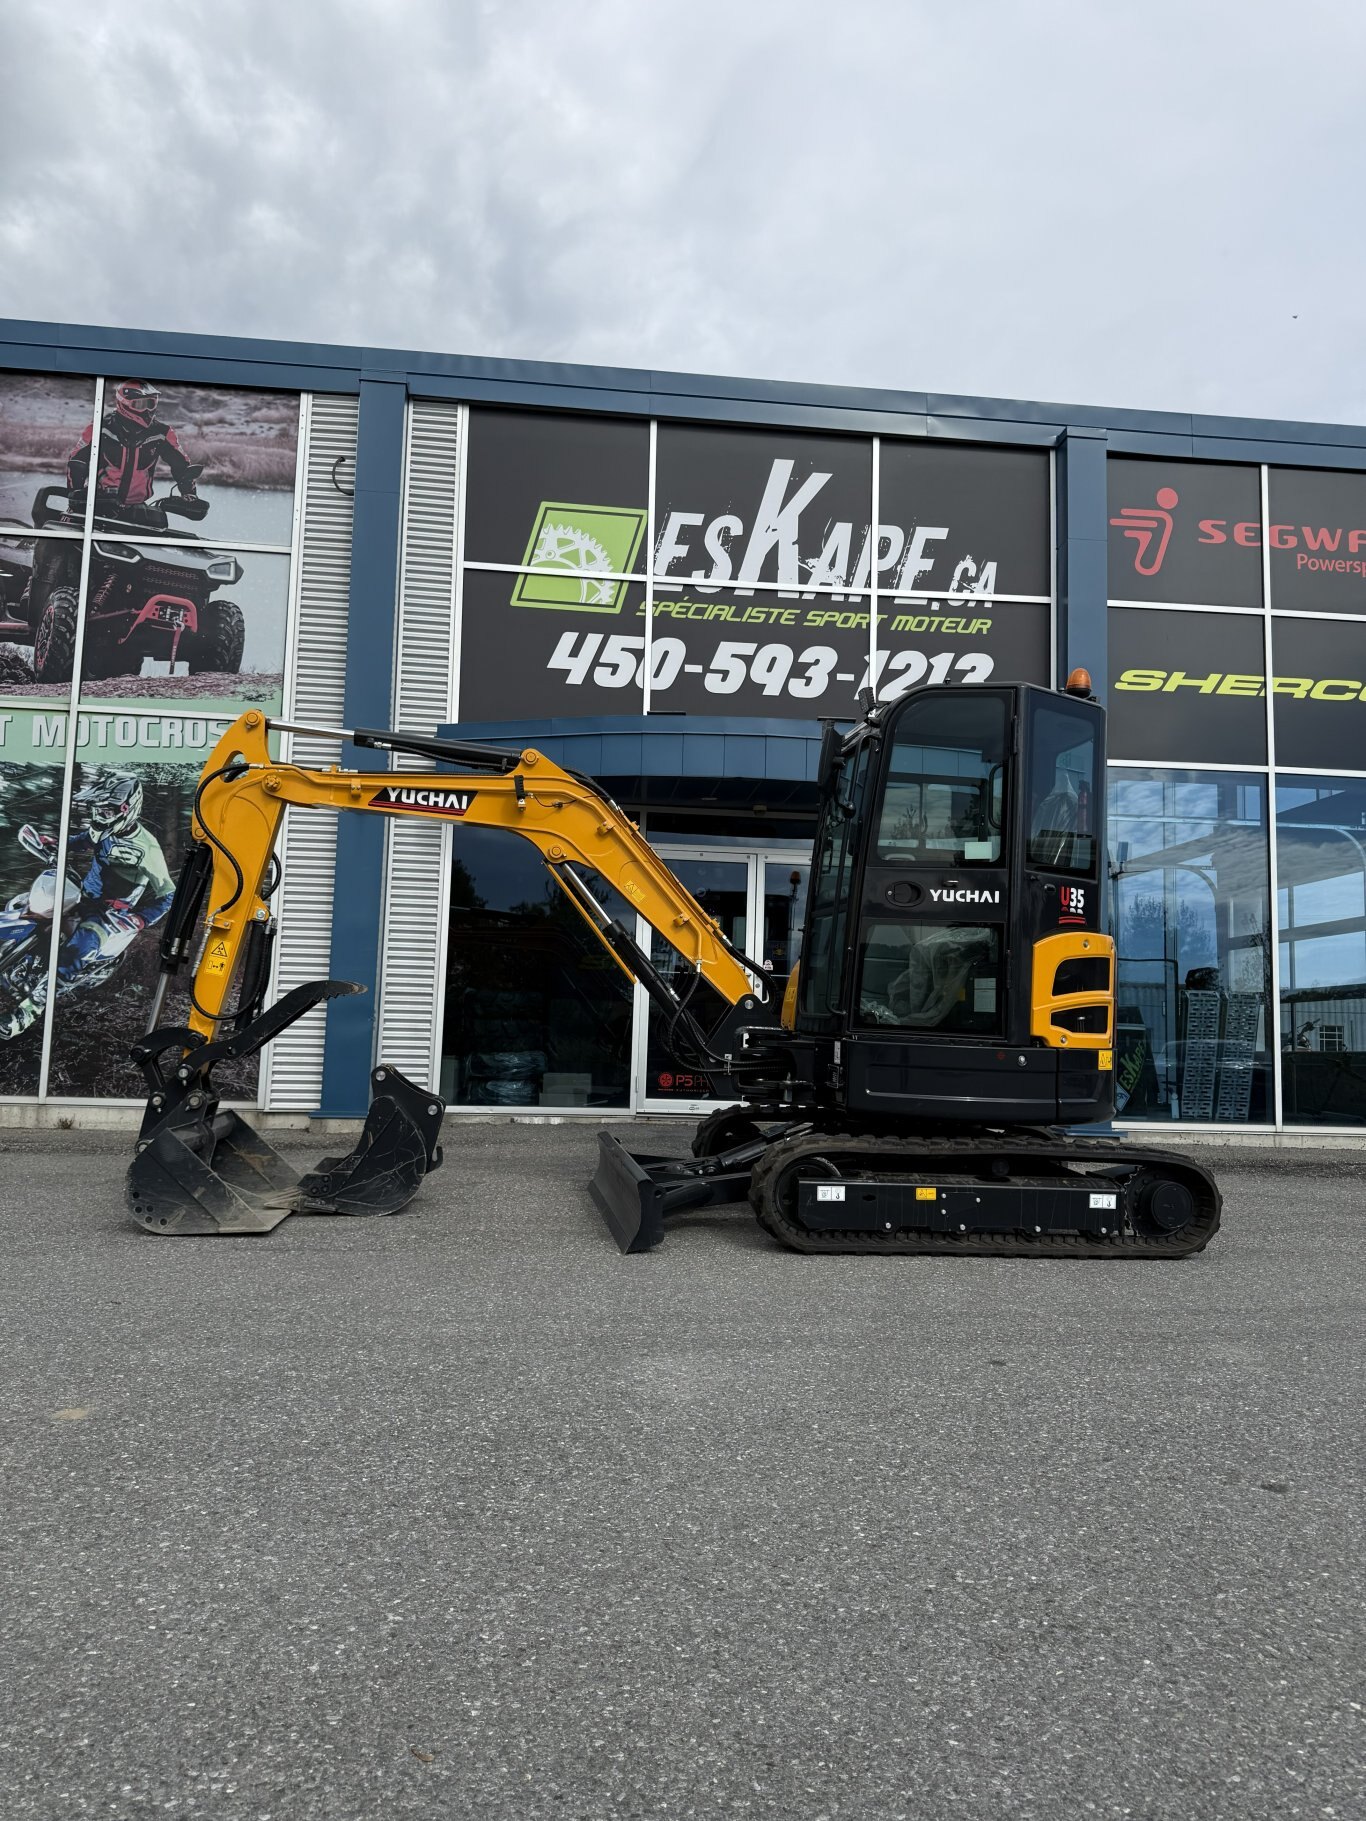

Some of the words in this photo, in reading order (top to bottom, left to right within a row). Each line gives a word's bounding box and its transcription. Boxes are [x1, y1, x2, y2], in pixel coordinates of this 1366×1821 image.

[635, 596, 801, 625] SPÉCIALISTE
[803, 610, 888, 629] SPORT
[890, 615, 993, 634] MOTEUR
[1115, 669, 1366, 702] SHERC
[32, 715, 229, 748] MOTOCROS
[386, 787, 468, 810] YUCHAI
[929, 888, 1000, 904] YUCHAI
[1060, 886, 1085, 908] U35
